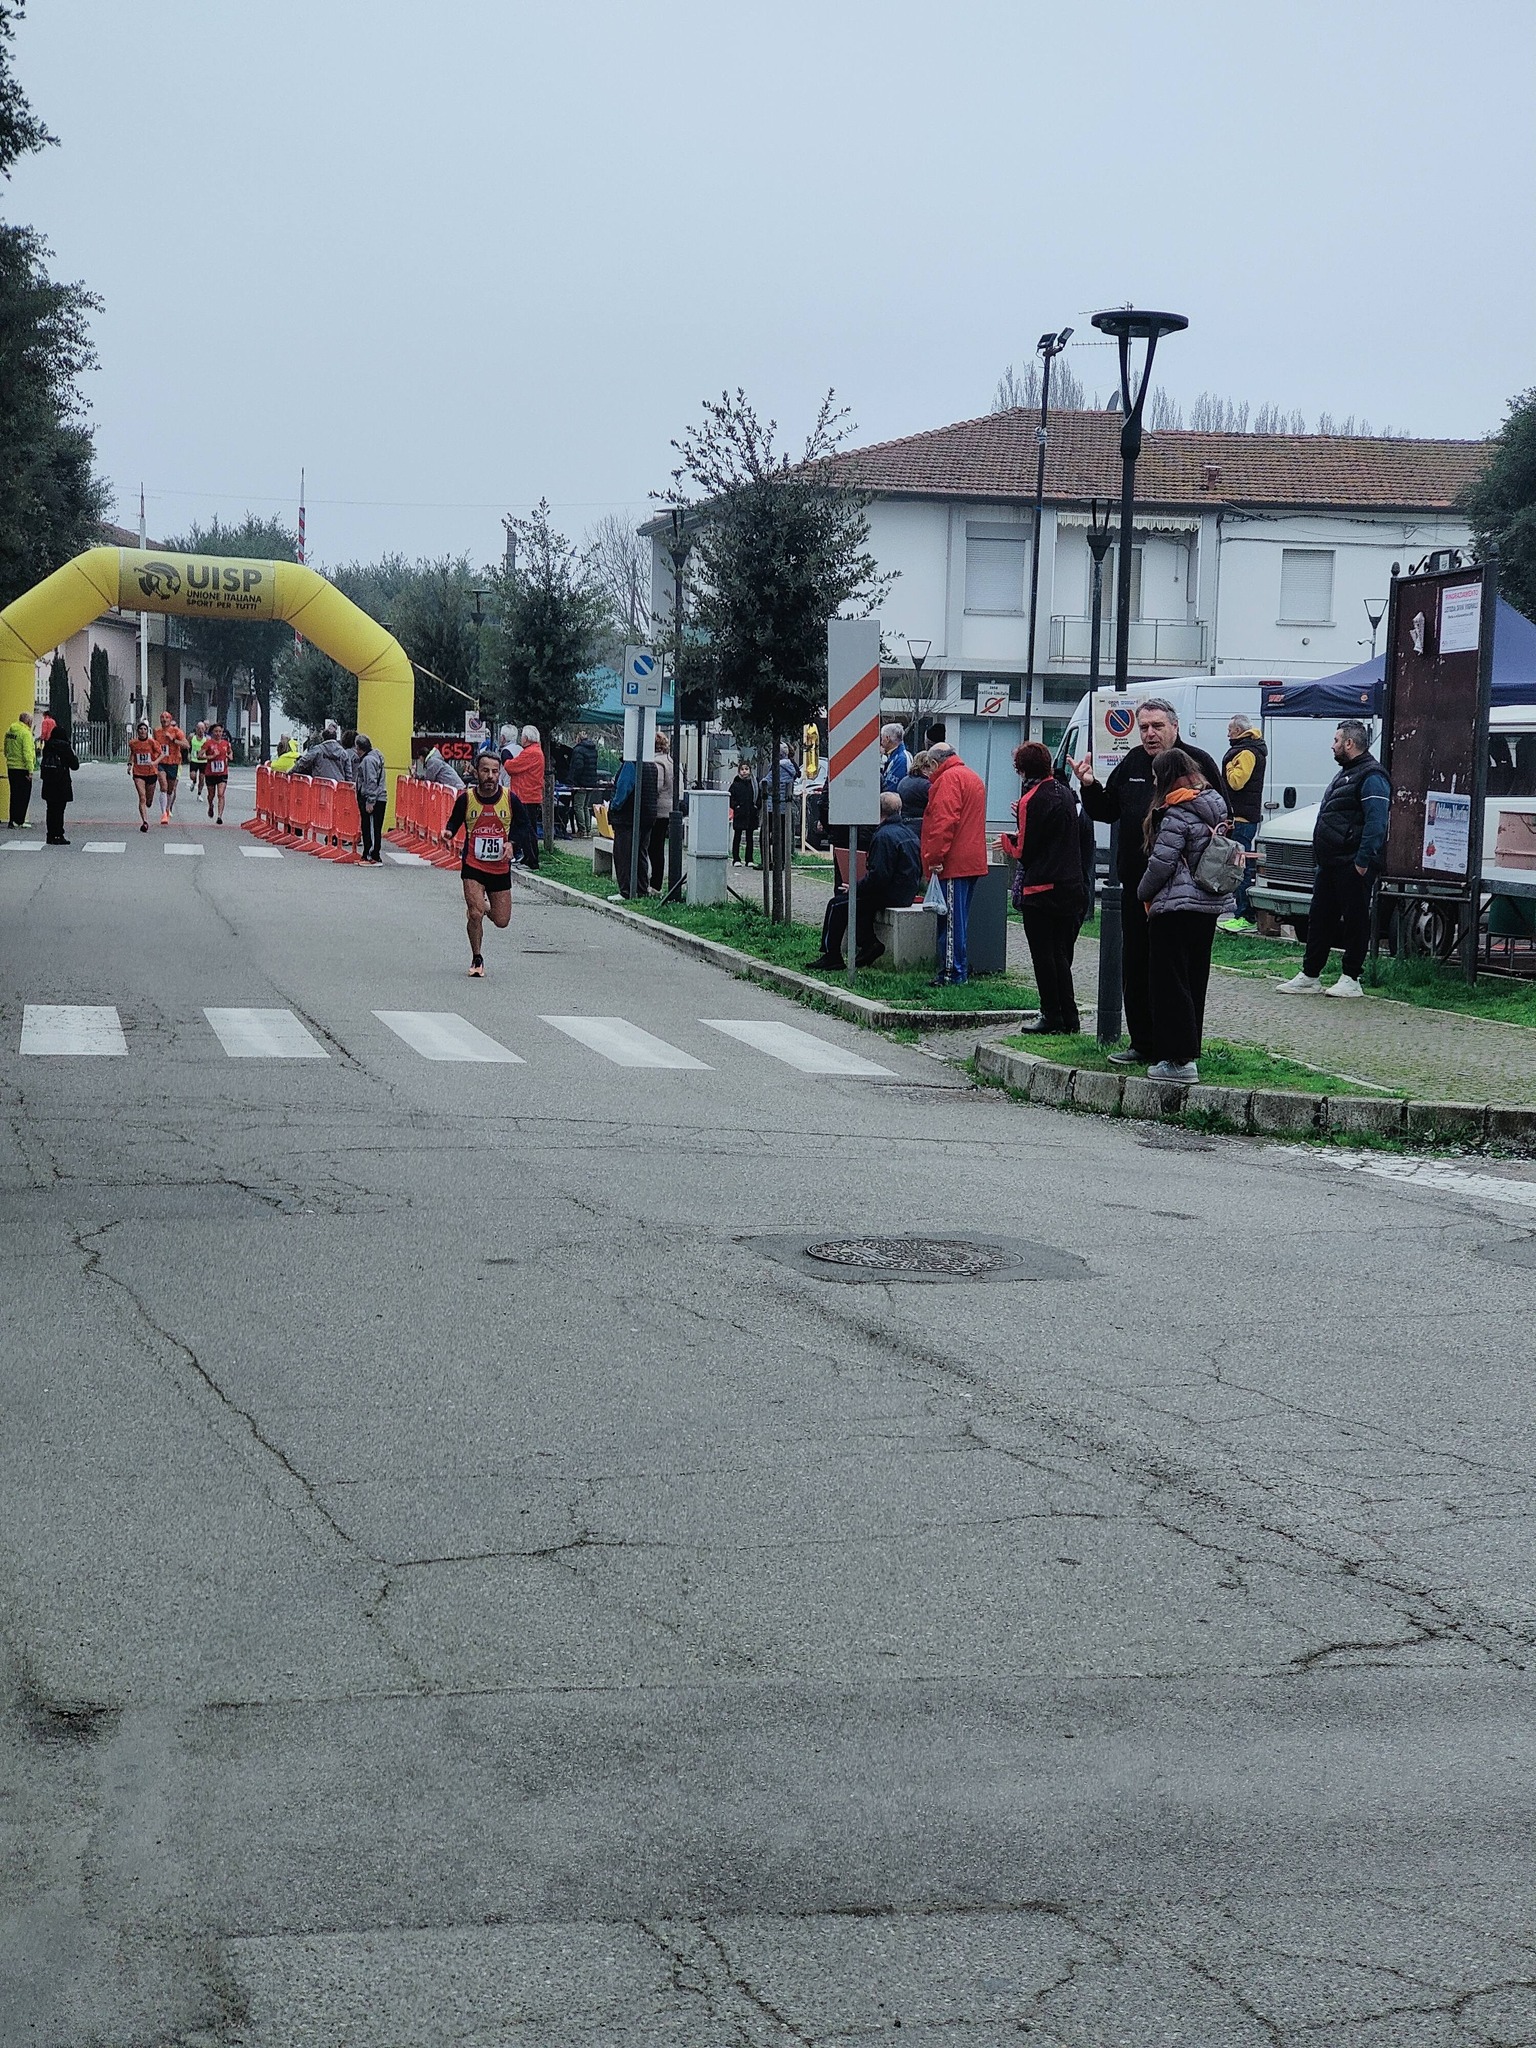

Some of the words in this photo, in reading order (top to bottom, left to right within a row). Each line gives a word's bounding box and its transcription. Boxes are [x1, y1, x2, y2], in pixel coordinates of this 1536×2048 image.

[187, 564, 262, 592] UISP
[187, 590, 220, 600] UNIONE
[224, 592, 261, 603] ITALIANA
[187, 599, 213, 608] SPORT
[481, 838, 500, 854] 735
